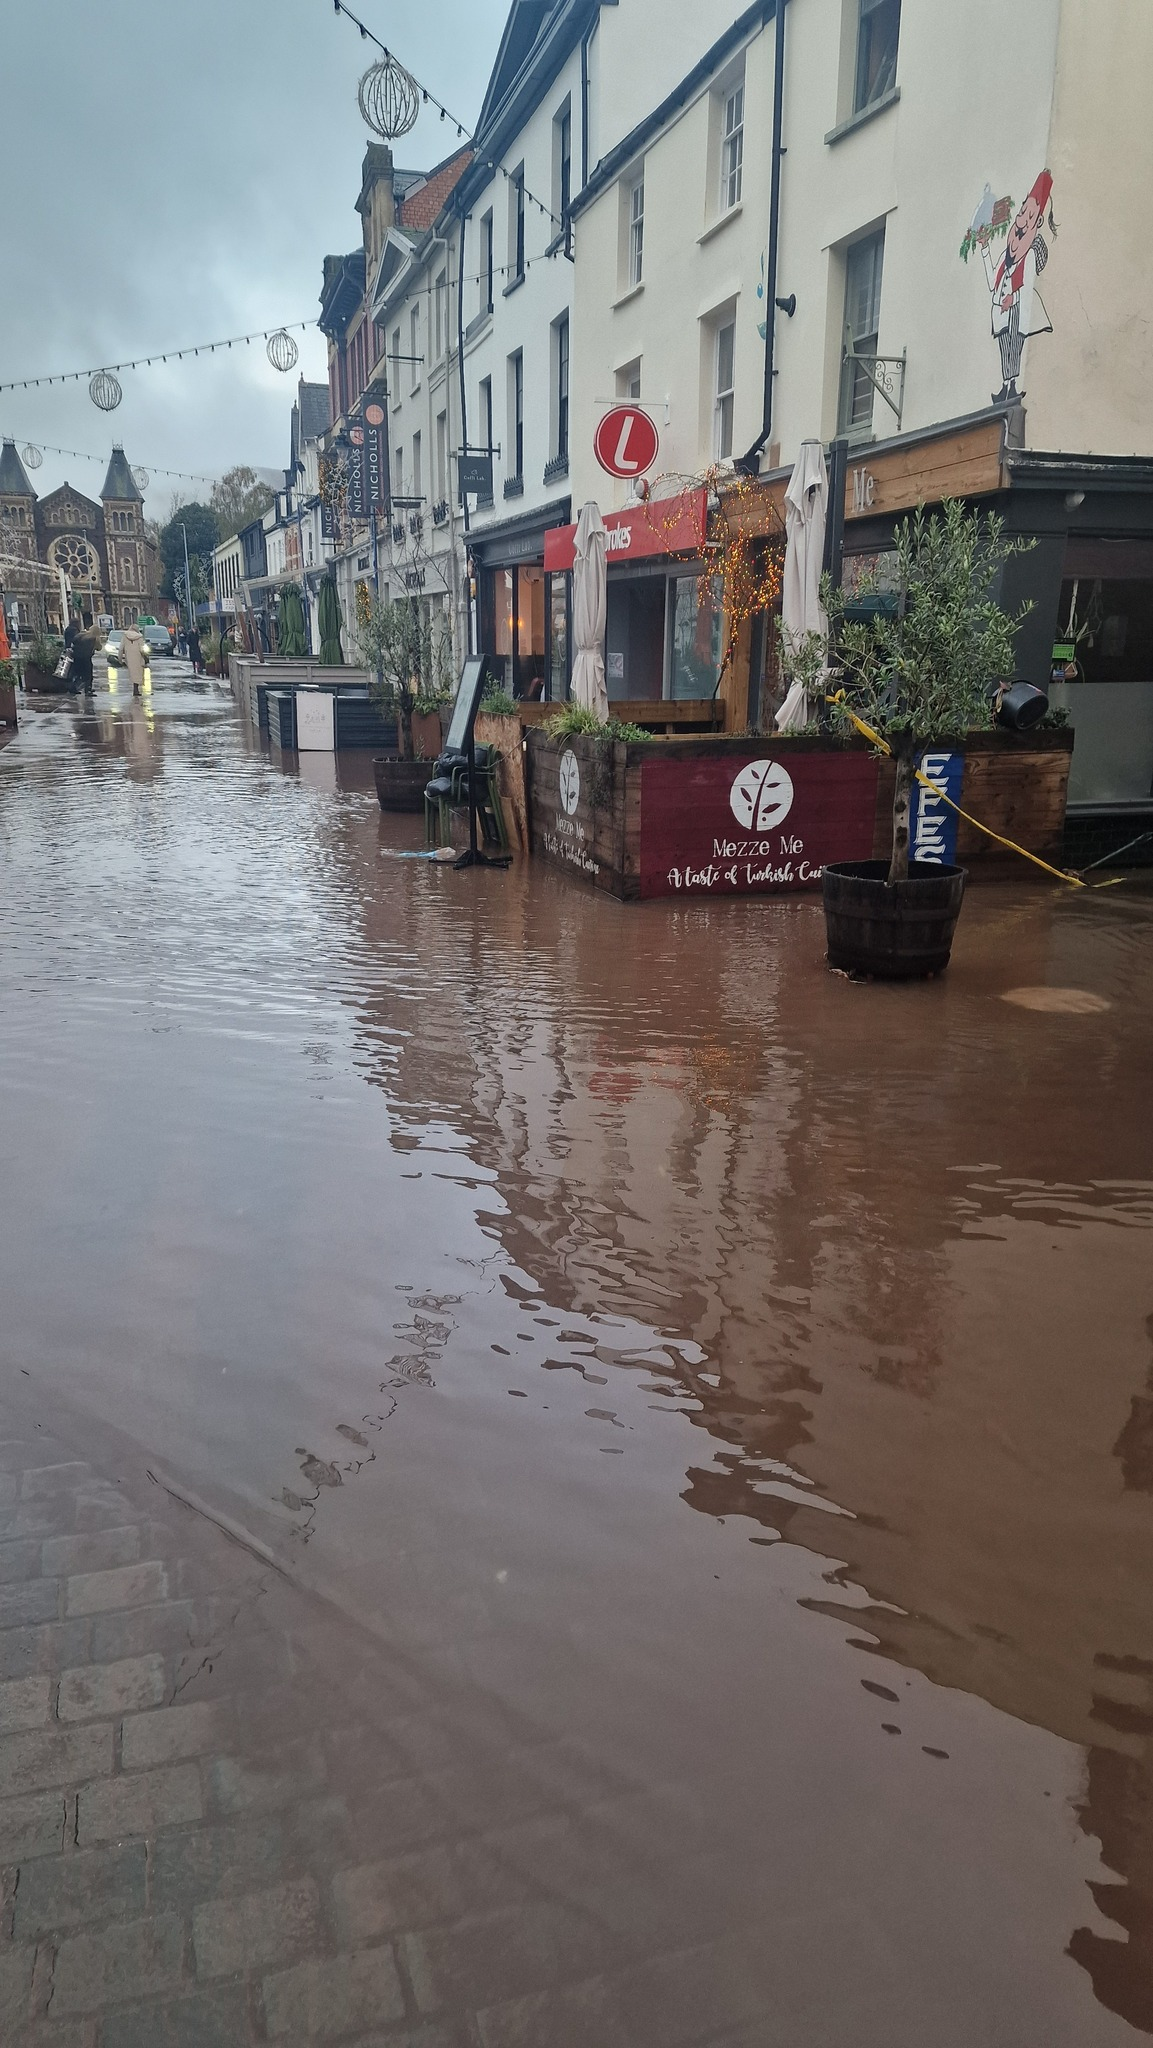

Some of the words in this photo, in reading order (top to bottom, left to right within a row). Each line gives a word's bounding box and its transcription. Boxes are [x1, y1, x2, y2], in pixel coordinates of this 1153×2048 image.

[614, 415, 639, 470] L
[368, 429, 379, 500] NICHOLLS
[851, 466, 874, 513] Me
[555, 812, 574, 837] Mezze
[575, 821, 585, 842] Me
[712, 838, 770, 858] Mezze
[779, 835, 804, 855] Me
[667, 867, 682, 888] A
[682, 864, 722, 887] taste
[724, 865, 738, 885] of
[795, 860, 825, 881] Cui
